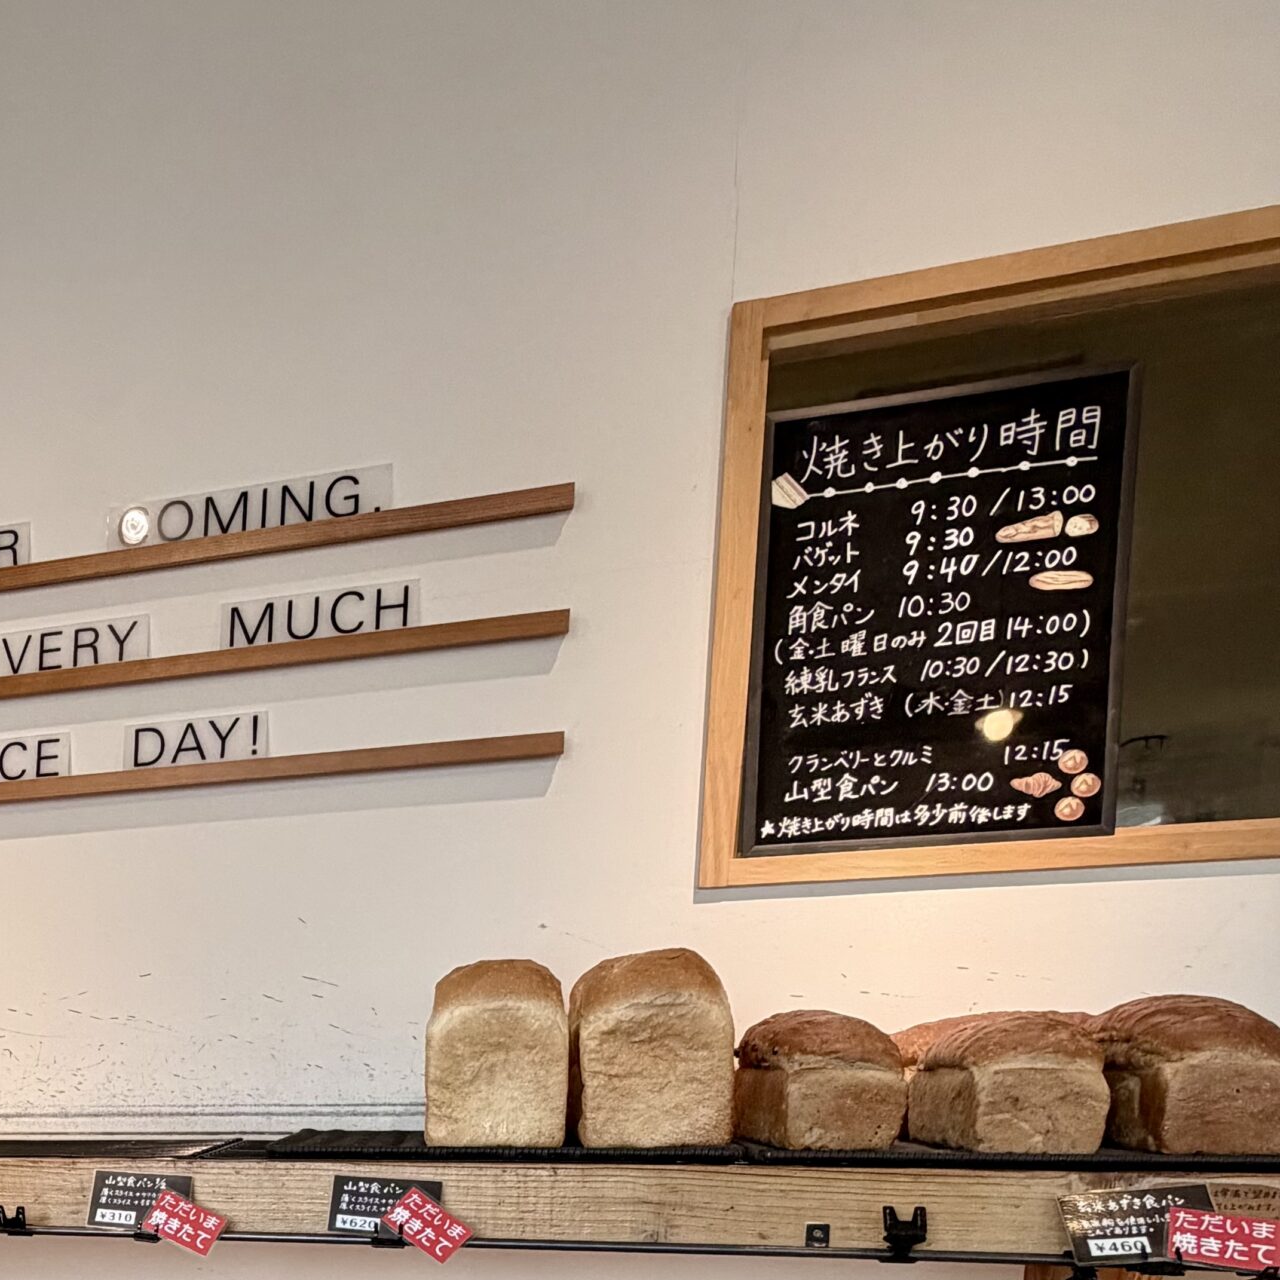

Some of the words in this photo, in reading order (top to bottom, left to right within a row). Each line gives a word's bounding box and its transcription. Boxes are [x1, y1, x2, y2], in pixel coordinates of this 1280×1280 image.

[799, 405, 1102, 484] 焼き上がり時間
[795, 510, 861, 543] コルネ
[792, 541, 860, 571] バゲット
[904, 527, 974, 556] 9:30
[786, 568, 862, 600] メンタイ
[4, 622, 140, 675] VERY
[228, 584, 411, 648] MUCH
[788, 602, 875, 636] 角食パン
[898, 591, 971, 618] 10:30
[784, 664, 897, 697] 練乳フランス
[787, 691, 884, 728] 玄米あずき
[133, 714, 261, 768] DAY!
[788, 743, 933, 775] クランベリーとクルミ
[1004, 738, 1070, 765] 12:15
[784, 771, 900, 803] 山型食パン
[925, 772, 995, 793] 13:00
[100, 1211, 132, 1223] ¥310
[148, 1209, 211, 1249] 焼きたて
[160, 1195, 220, 1231] ただいま
[388, 1206, 453, 1257] 焼きたて
[404, 1193, 467, 1241] ただいま
[1175, 1211, 1277, 1239] ただいま
[1171, 1231, 1276, 1265] 焼きたて
